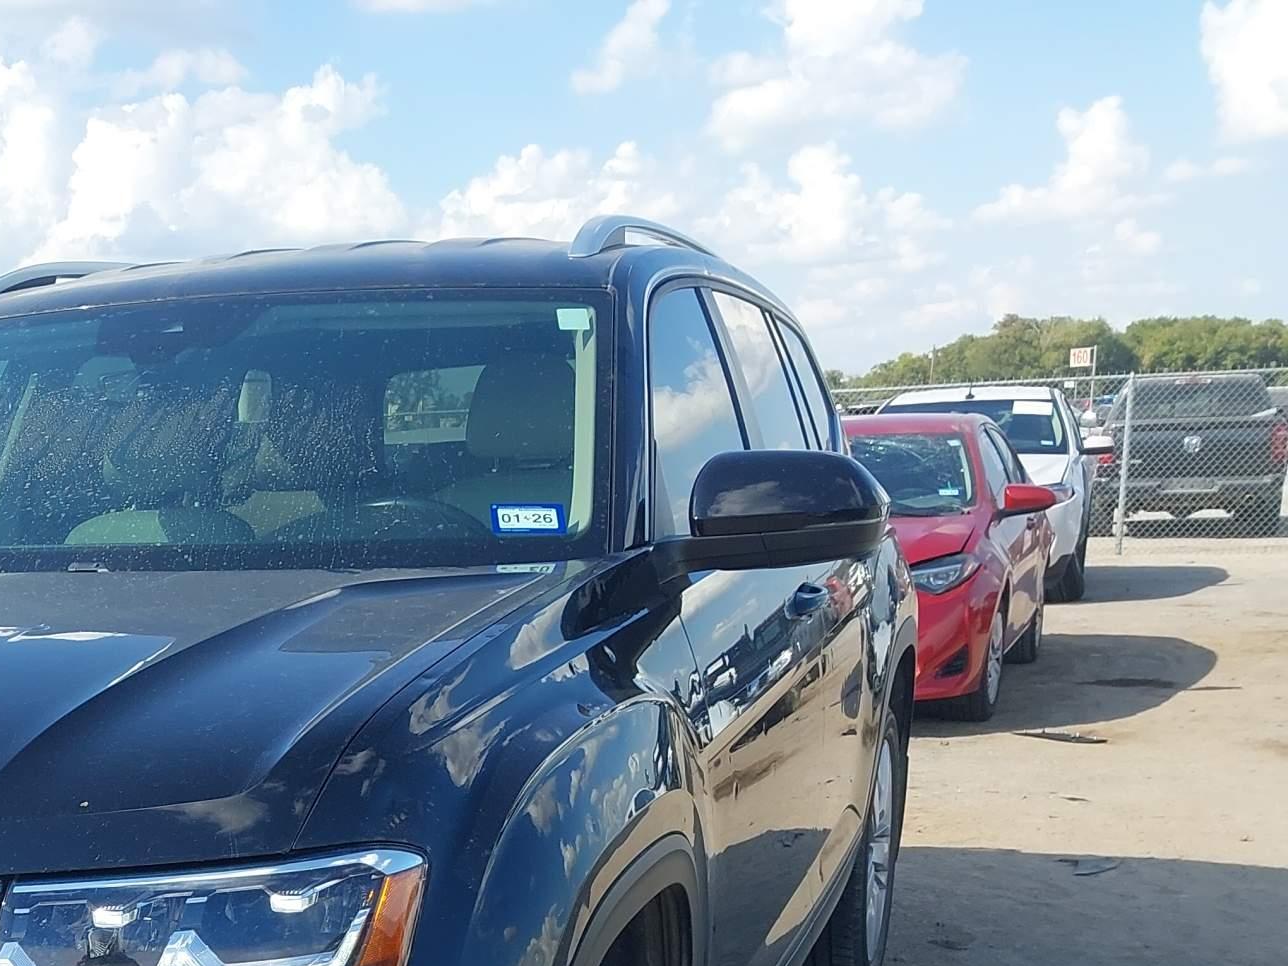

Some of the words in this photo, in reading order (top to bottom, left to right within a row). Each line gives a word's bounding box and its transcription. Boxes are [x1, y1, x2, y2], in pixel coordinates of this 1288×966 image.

[1072, 350, 1088, 364] 160
[501, 513, 520, 524] 01
[531, 513, 553, 524] 26
